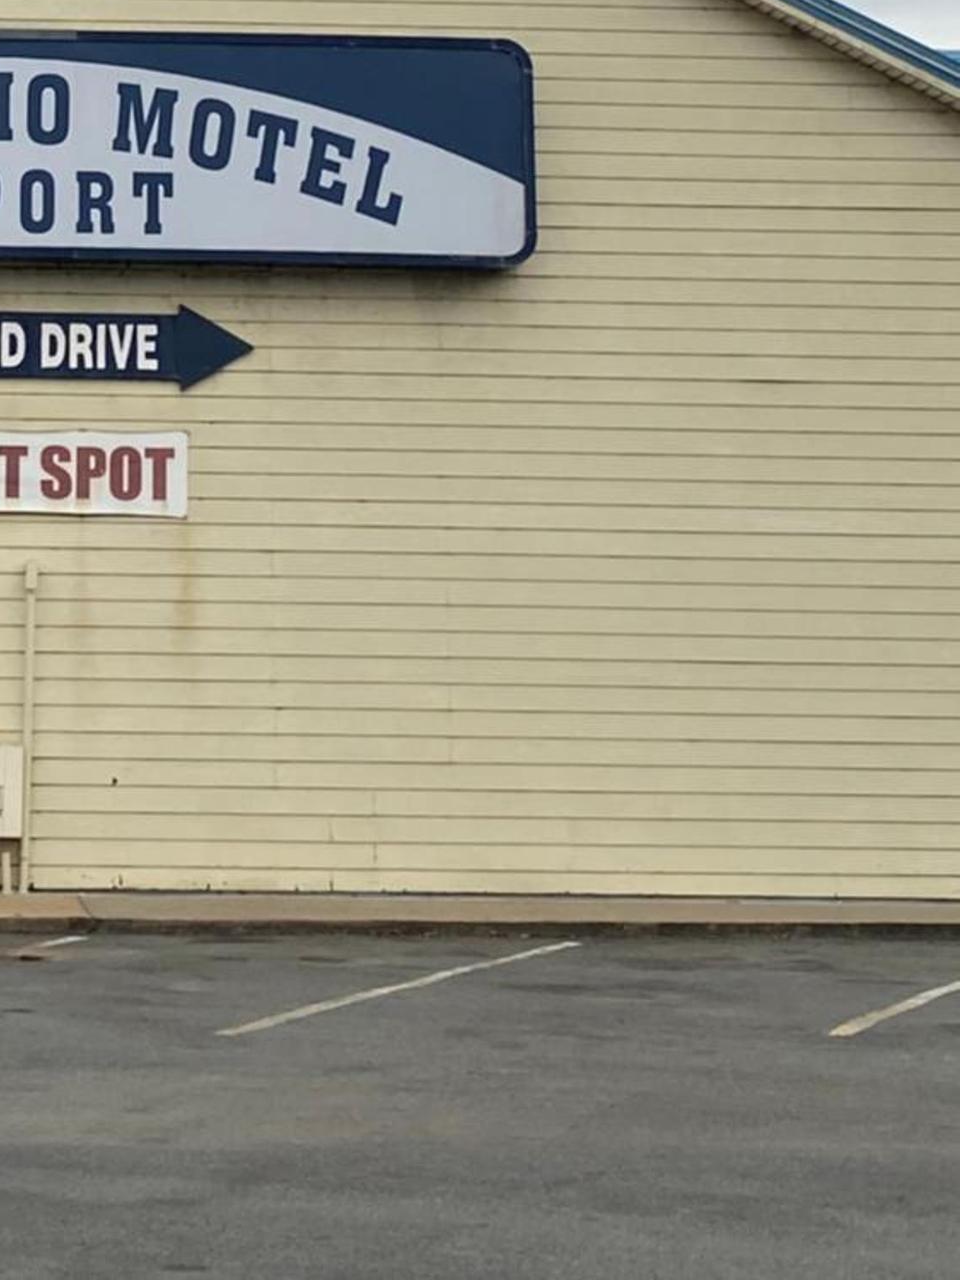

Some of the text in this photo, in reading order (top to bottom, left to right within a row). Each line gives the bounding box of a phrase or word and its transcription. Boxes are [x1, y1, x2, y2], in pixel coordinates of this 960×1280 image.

[112, 82, 404, 226] MOTEL
[40, 322, 159, 371] DRIVE
[40, 446, 175, 501] SPOT
